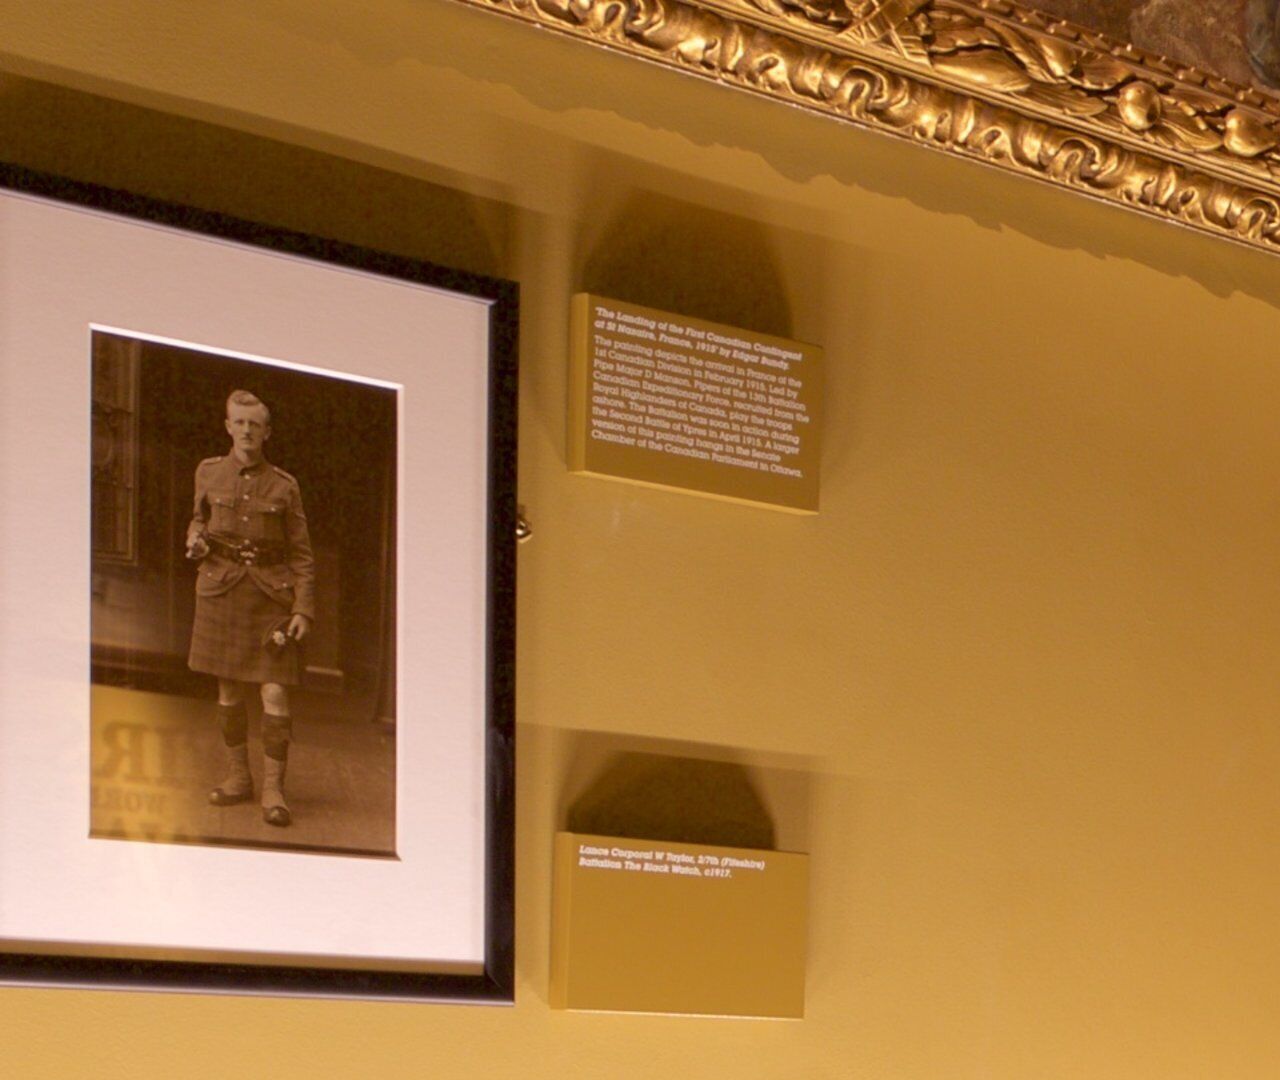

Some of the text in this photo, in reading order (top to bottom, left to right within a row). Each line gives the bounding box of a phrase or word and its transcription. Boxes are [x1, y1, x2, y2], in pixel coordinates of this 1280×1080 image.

[607, 322, 616, 331] St
[659, 334, 692, 348] France,
[720, 347, 731, 357] by
[733, 350, 759, 362] Edgar
[617, 312, 656, 329] Landing
[658, 323, 667, 331] of
[669, 324, 684, 334] the
[686, 328, 705, 338] First
[707, 333, 751, 349] Canadian
[754, 343, 802, 360] Contingent
[594, 359, 614, 370] Pipe
[616, 364, 643, 376] Major
[645, 369, 652, 378] D
[695, 380, 720, 393] Pipers
[733, 389, 747, 398] the
[750, 392, 766, 402] 13th
[769, 396, 805, 410] Battalion
[595, 335, 612, 346] The
[614, 341, 653, 356] painting
[655, 350, 687, 363] depicts
[689, 357, 704, 366] the
[705, 361, 734, 373] arrival
[736, 367, 745, 376] in
[747, 369, 776, 382] France
[788, 378, 802, 387] the
[596, 347, 607, 359] 1st
[609, 351, 655, 367] Canadian
[658, 361, 691, 375] Division
[694, 369, 702, 378] in
[705, 371, 744, 387] February
[769, 385, 785, 395] Led
[787, 389, 798, 399] by
[594, 371, 640, 387] Canadian
[643, 381, 703, 401] Expeditionary
[734, 402, 772, 415] recruited
[775, 409, 794, 419] from
[796, 413, 809, 422] the
[594, 382, 619, 395] Royal
[621, 388, 676, 406] Highlanders
[678, 401, 687, 409] of
[730, 412, 749, 422] play
[751, 415, 765, 424] the
[767, 419, 792, 430] troops
[592, 419, 781, 461] version of this painting hangs in the Senate
[593, 407, 607, 416] the
[610, 409, 643, 423] Second
[645, 416, 671, 428] Battle
[672, 423, 681, 431] of
[683, 424, 707, 436] Ypres
[709, 430, 718, 438] in
[719, 432, 740, 442] April
[765, 441, 772, 449] A
[773, 443, 799, 454] larger
[629, 401, 646, 412] The
[648, 405, 688, 420] Battalion
[690, 416, 707, 424] was
[709, 419, 730, 429] soon
[732, 423, 740, 431] in
[742, 426, 769, 437] action
[771, 431, 799, 444] during
[592, 430, 802, 477] Chamber of the Canadian Parliament in Ottawa.
[580, 846, 609, 855] Lance
[611, 848, 653, 859] Corporal
[655, 852, 664, 860] W
[667, 853, 695, 863] Taylor,
[580, 857, 622, 868] Battalion
[625, 861, 641, 870] The
[644, 863, 669, 872] Black
[672, 865, 701, 875] Watch,
